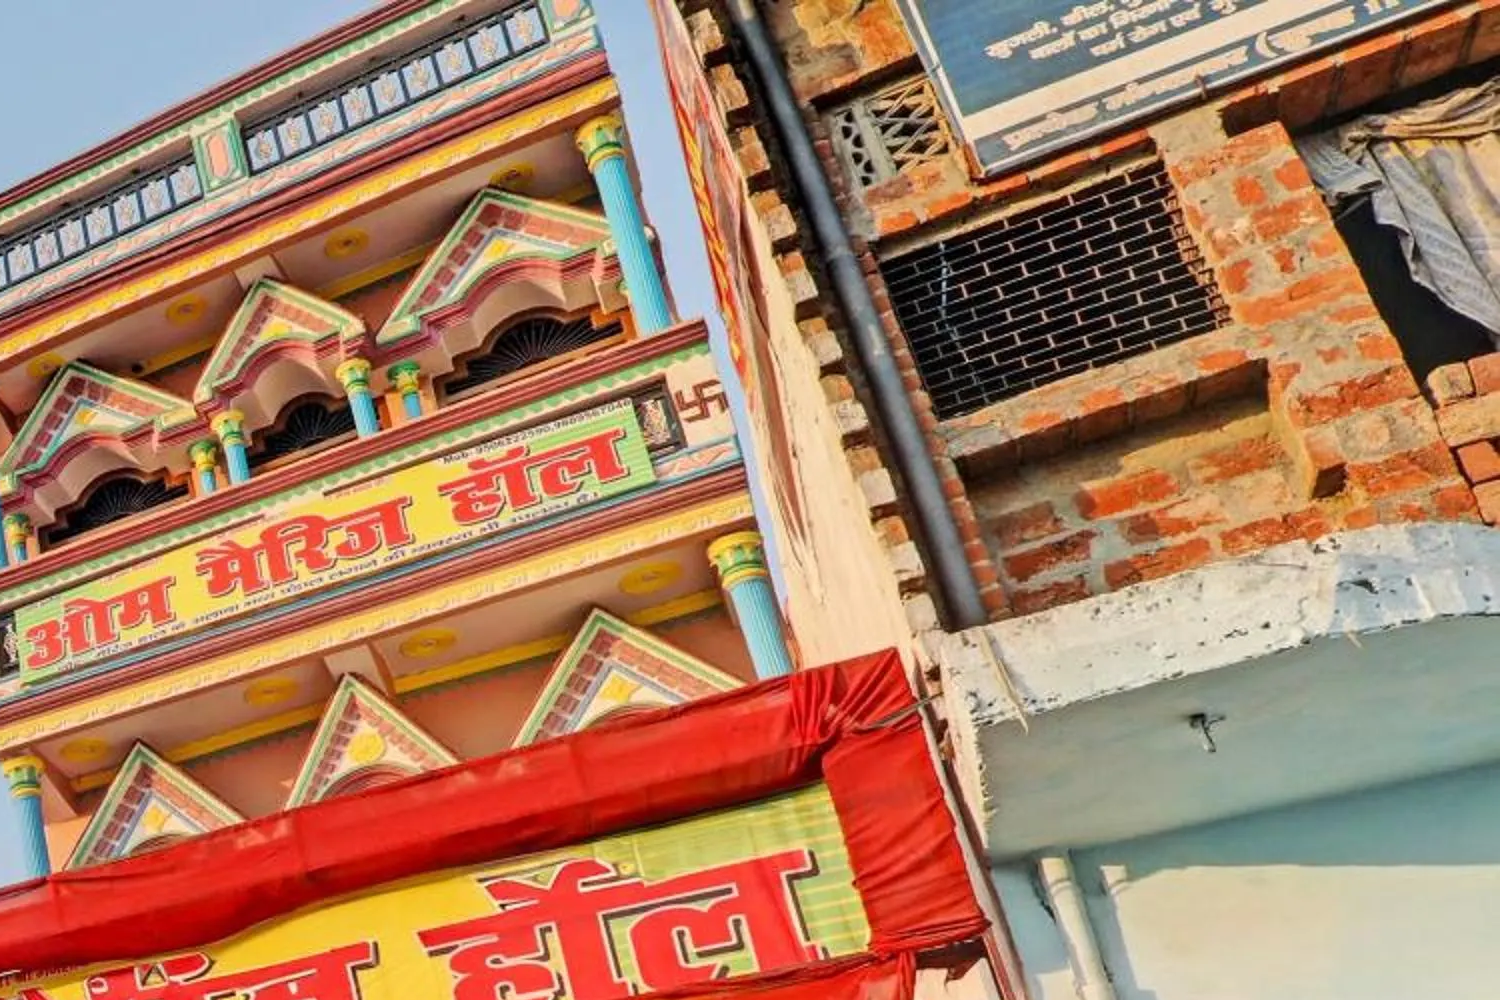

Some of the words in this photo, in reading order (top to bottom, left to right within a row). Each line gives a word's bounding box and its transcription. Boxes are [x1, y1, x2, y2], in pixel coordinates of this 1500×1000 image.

[25, 575, 177, 670] ओम
[195, 495, 416, 598] मैरिज
[437, 426, 631, 526] हॉल
